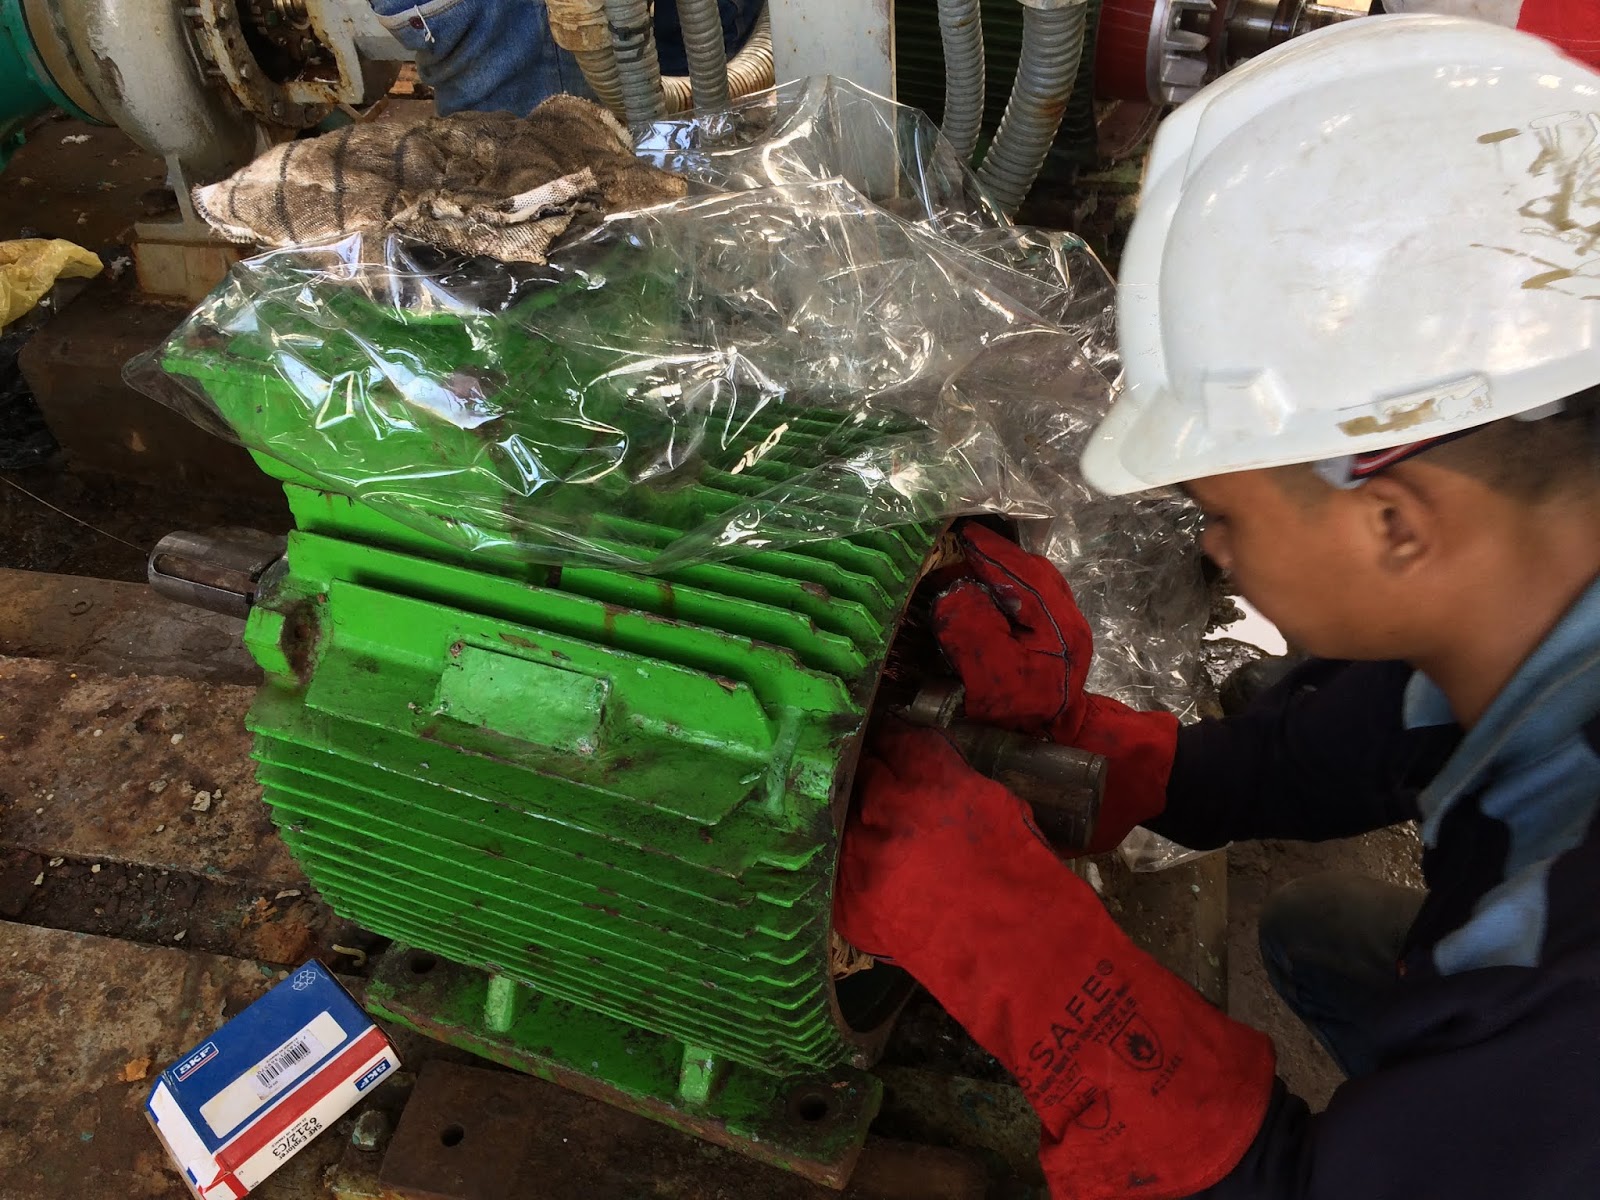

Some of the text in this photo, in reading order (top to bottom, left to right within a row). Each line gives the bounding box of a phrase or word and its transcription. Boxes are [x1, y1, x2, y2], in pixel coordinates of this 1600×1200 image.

[180, 1046, 210, 1074] SKF
[357, 1062, 387, 1088] SKF
[271, 1116, 318, 1157] 6212/C3
[277, 1122, 322, 1160] SKF Explorer
